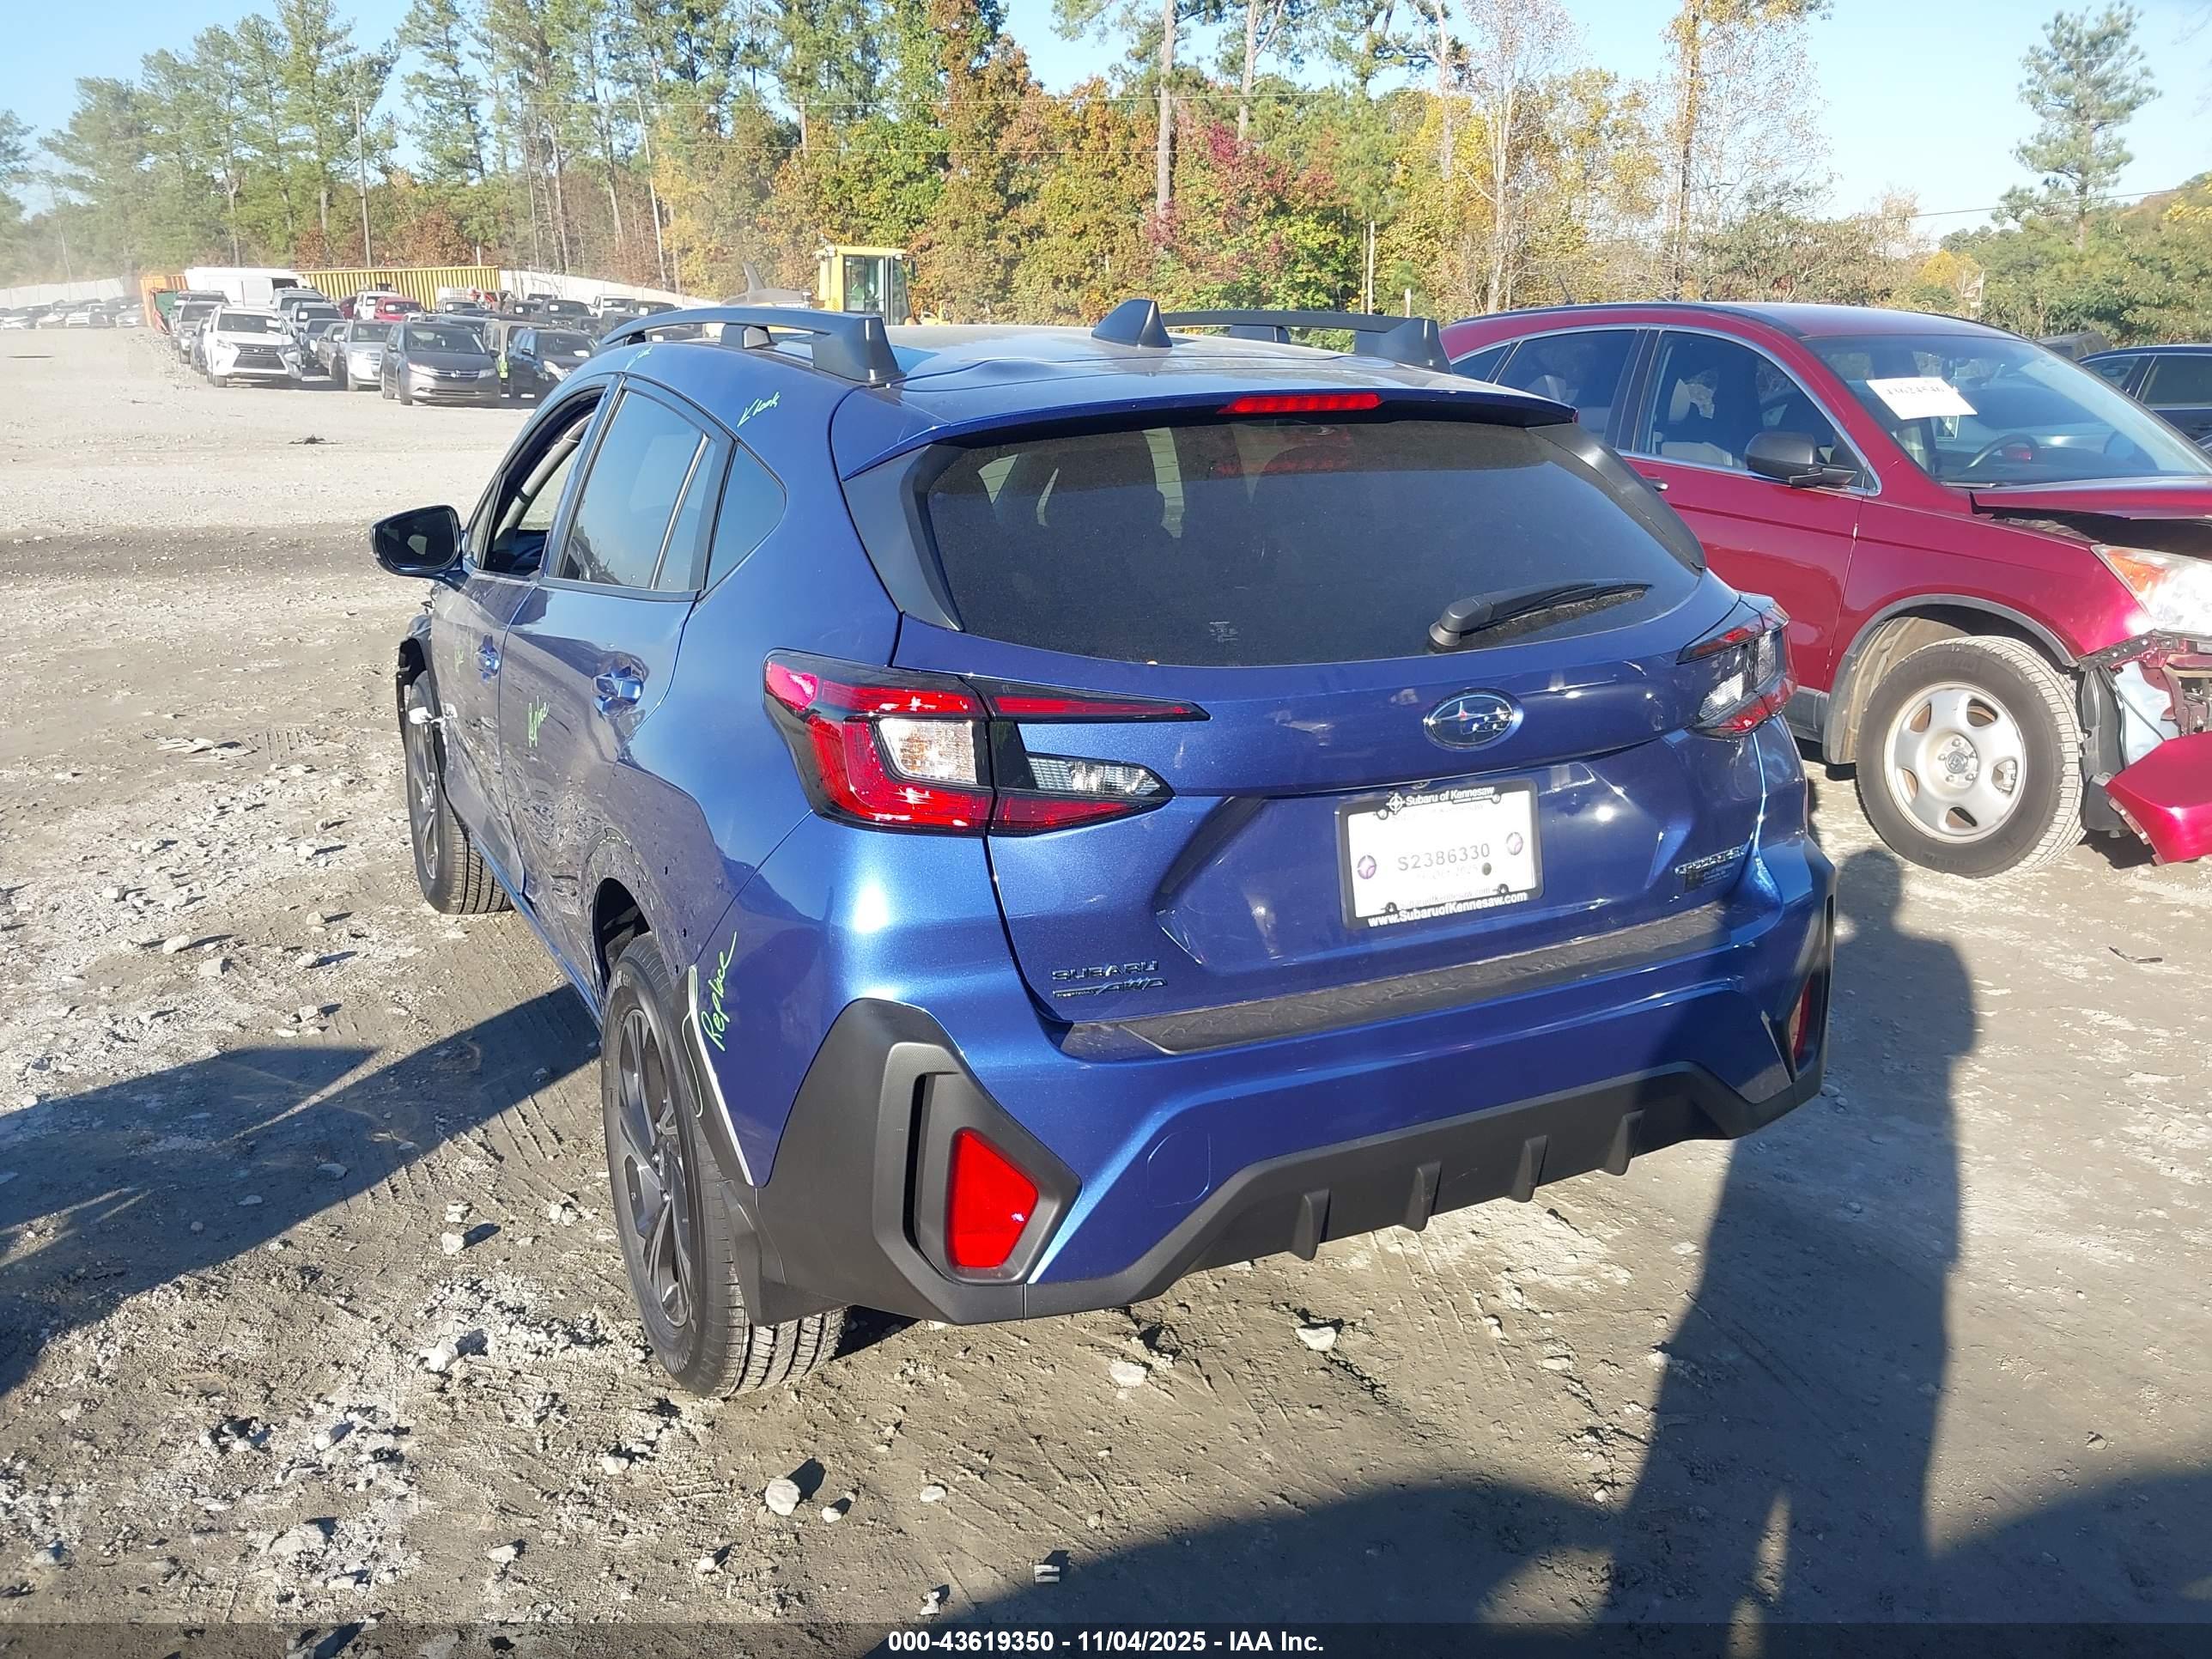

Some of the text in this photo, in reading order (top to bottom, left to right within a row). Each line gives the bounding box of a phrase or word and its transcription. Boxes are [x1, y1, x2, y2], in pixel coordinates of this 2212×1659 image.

[1406, 794, 1438, 805] Subaru
[1439, 792, 1449, 802] of
[1450, 787, 1495, 799] Kennesaw
[1397, 842, 1491, 872] S2386330
[1368, 891, 1528, 927] www.SubaruofKennesaw.com
[1052, 960, 1159, 981] SUBARU
